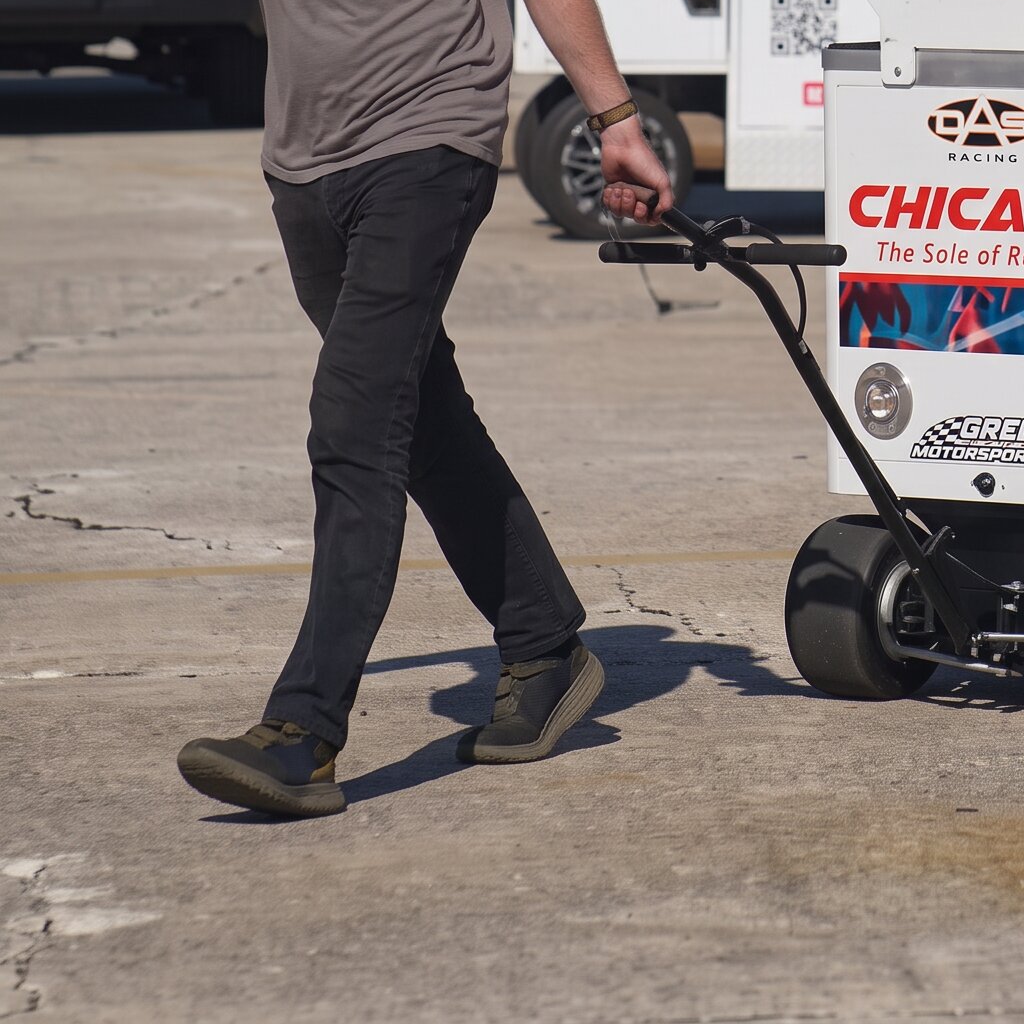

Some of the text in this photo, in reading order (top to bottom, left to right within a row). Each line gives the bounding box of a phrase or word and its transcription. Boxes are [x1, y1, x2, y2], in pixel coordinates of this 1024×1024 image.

[948, 152, 1018, 163] RACING
[877, 241, 914, 264] The
[923, 243, 969, 266] Sole
[978, 245, 1001, 266] of
